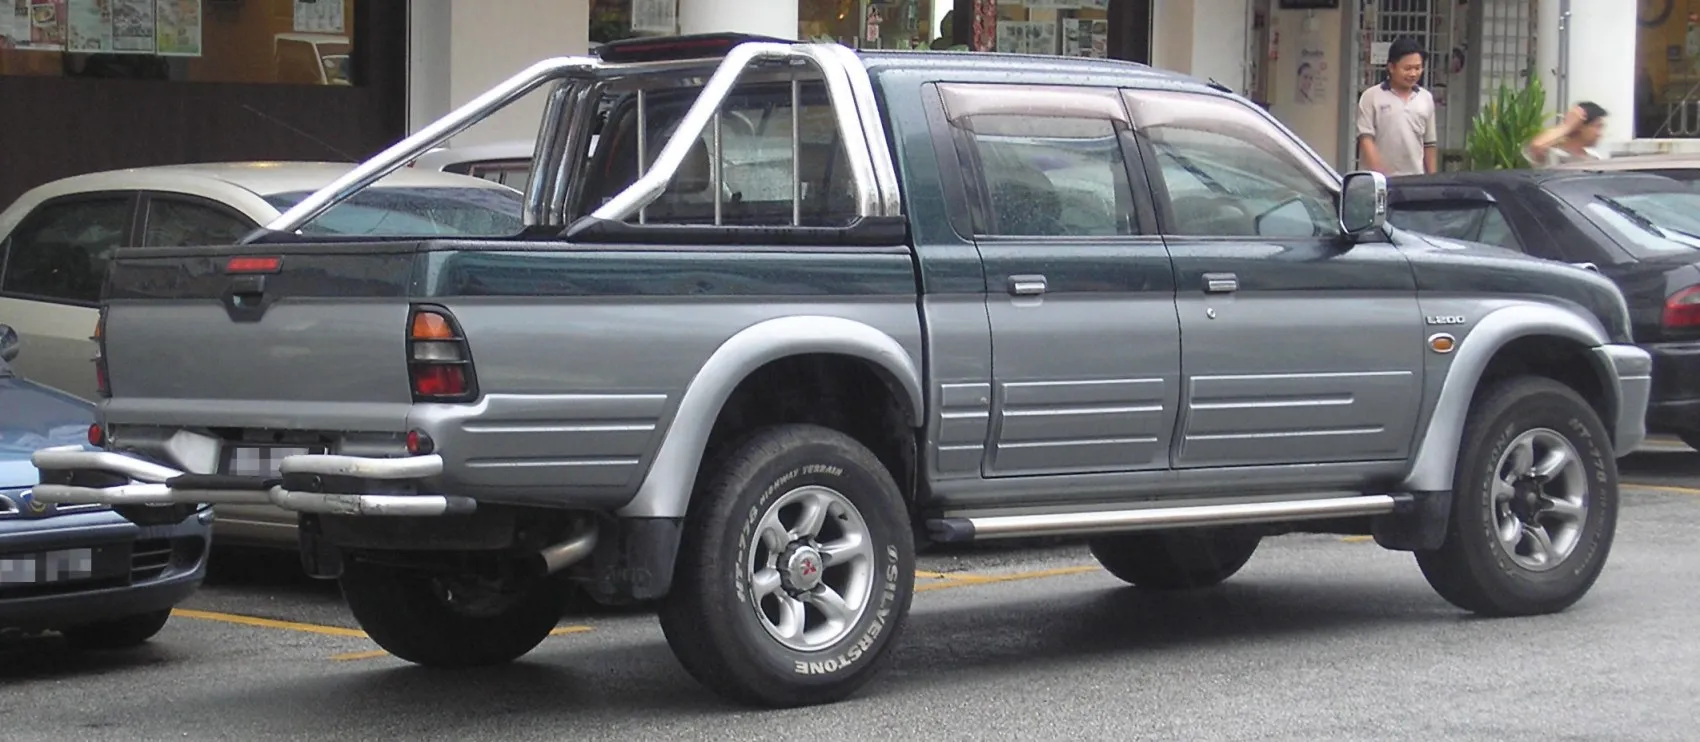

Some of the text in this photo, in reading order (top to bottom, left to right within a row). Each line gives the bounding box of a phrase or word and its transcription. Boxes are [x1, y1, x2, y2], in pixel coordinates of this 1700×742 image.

[1426, 315, 1465, 324] L200
[760, 468, 799, 505] HIGHWAY
[802, 464, 843, 477] TERRAIN
[795, 562, 898, 675] SILVERSTONE
